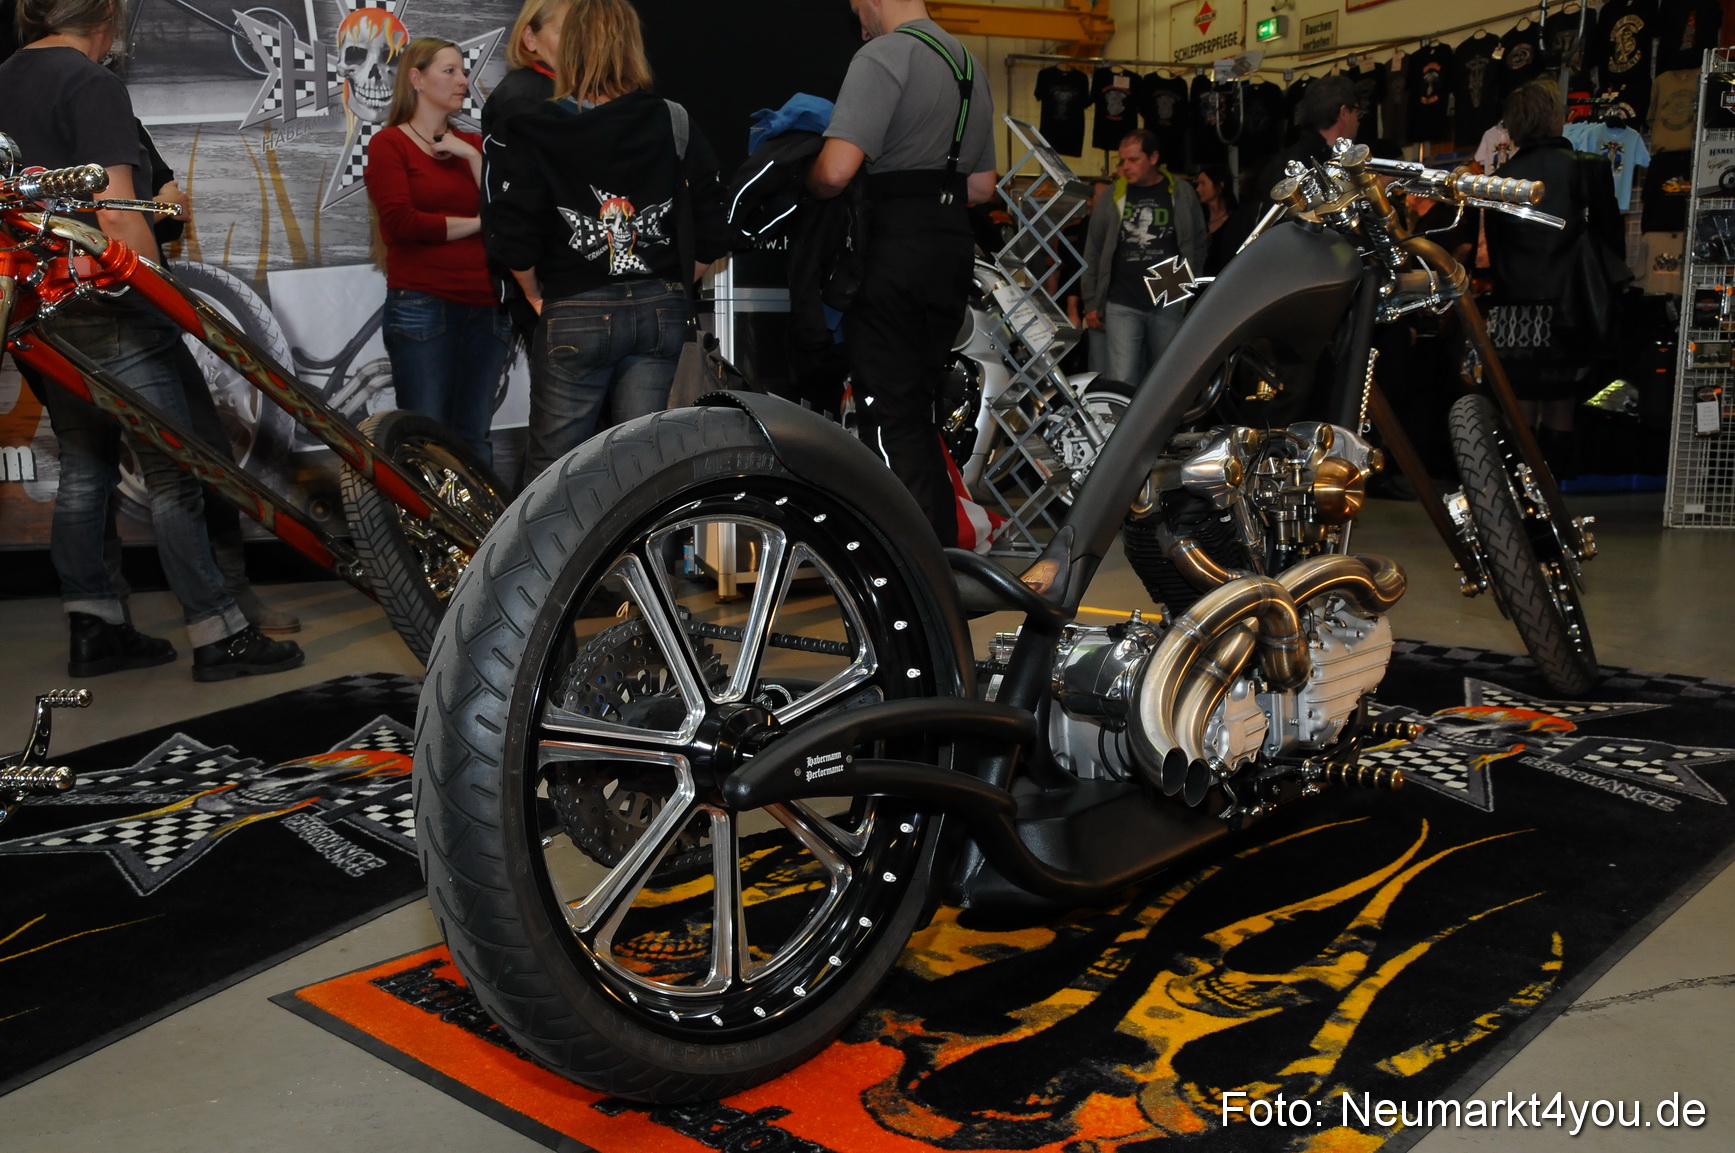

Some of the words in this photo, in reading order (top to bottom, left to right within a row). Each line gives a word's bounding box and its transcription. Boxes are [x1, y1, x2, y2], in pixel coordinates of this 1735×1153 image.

[1305, 21, 1332, 36] Rauchen
[1173, 31, 1238, 63] SCHLEPPERPFLEGE
[806, 751, 842, 768] Habermann
[805, 764, 845, 783] Performance
[1517, 755, 1682, 812] PERFORMANCE
[279, 811, 388, 878] PERFORMANCE
